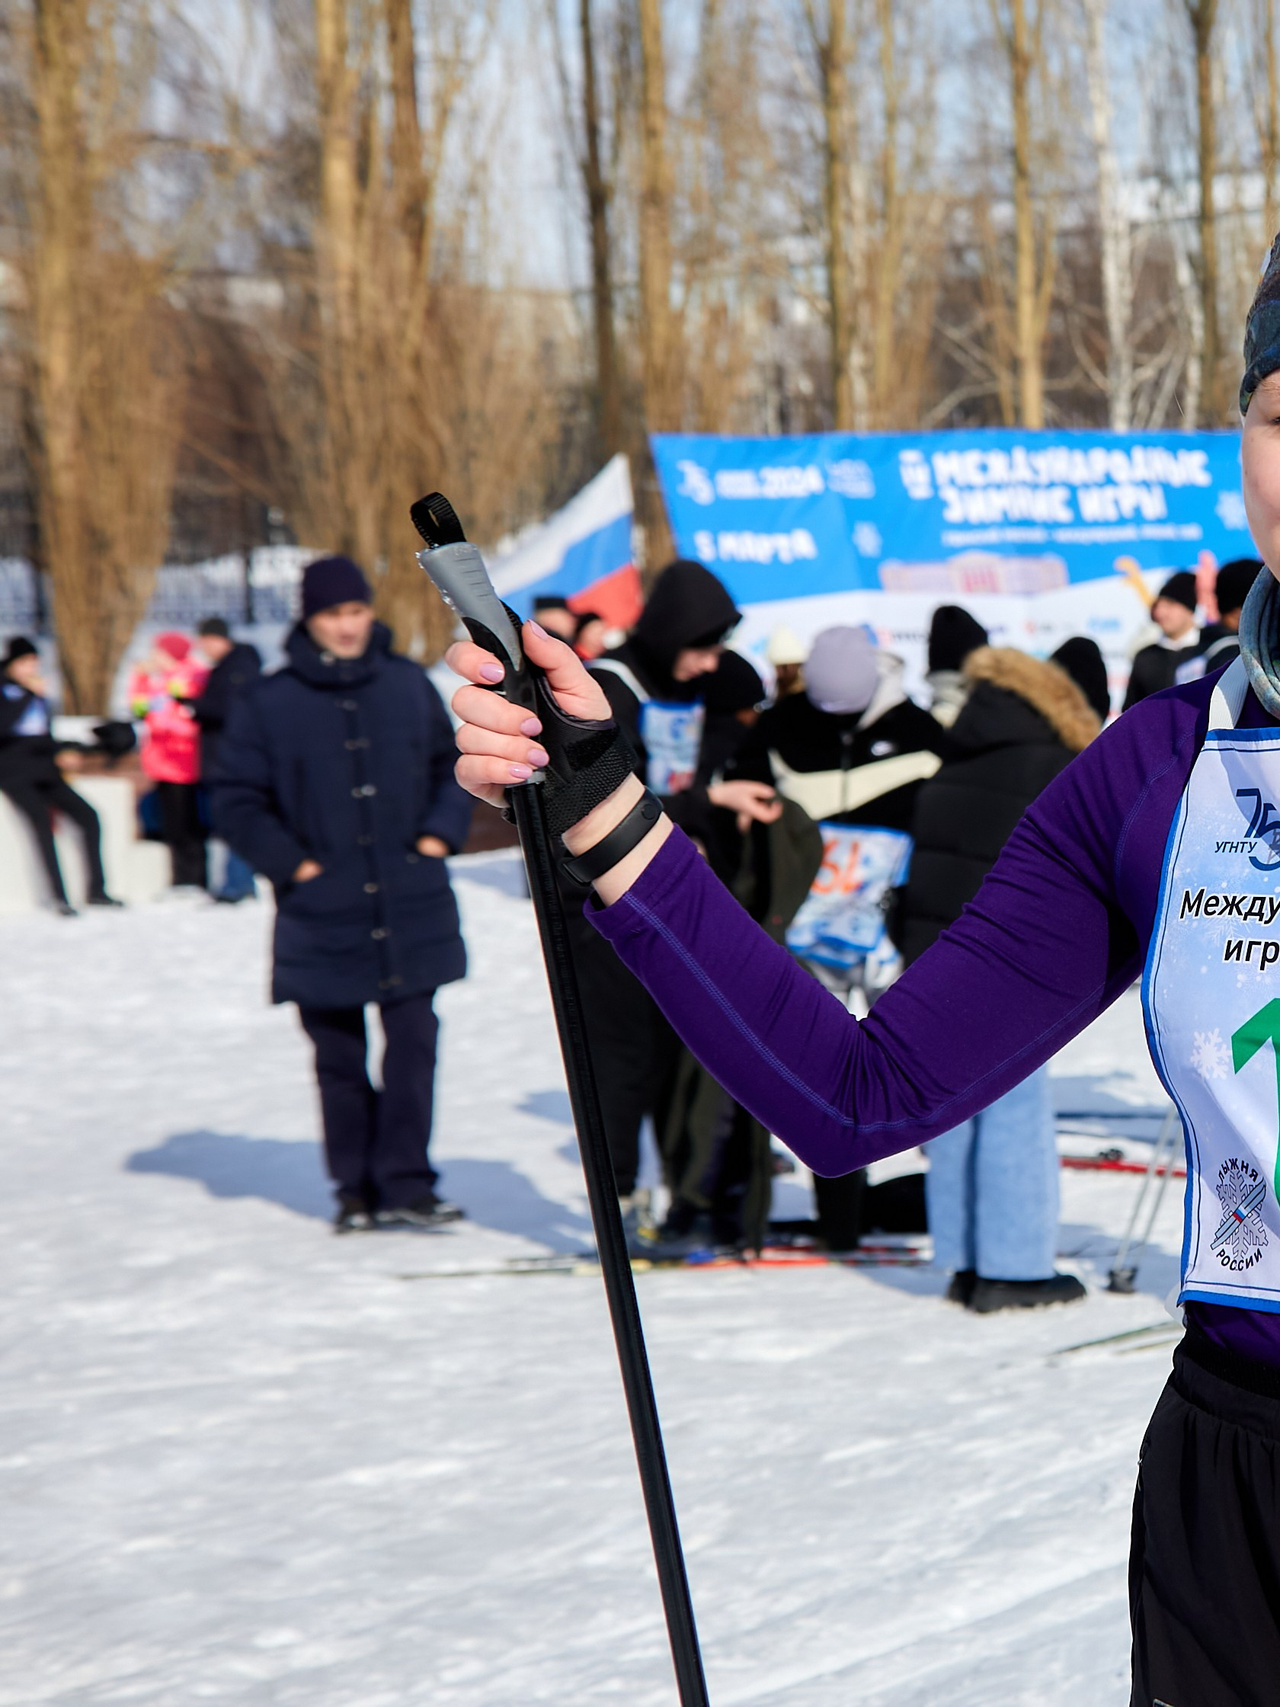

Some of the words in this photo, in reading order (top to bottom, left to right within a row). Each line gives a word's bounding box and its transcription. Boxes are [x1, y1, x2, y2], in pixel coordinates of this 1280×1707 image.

[1214, 841, 1258, 854] УГНТУ
[1218, 1158, 1259, 1183] ЛЫЖНЯ
[1216, 1248, 1263, 1272] РОССИИ
